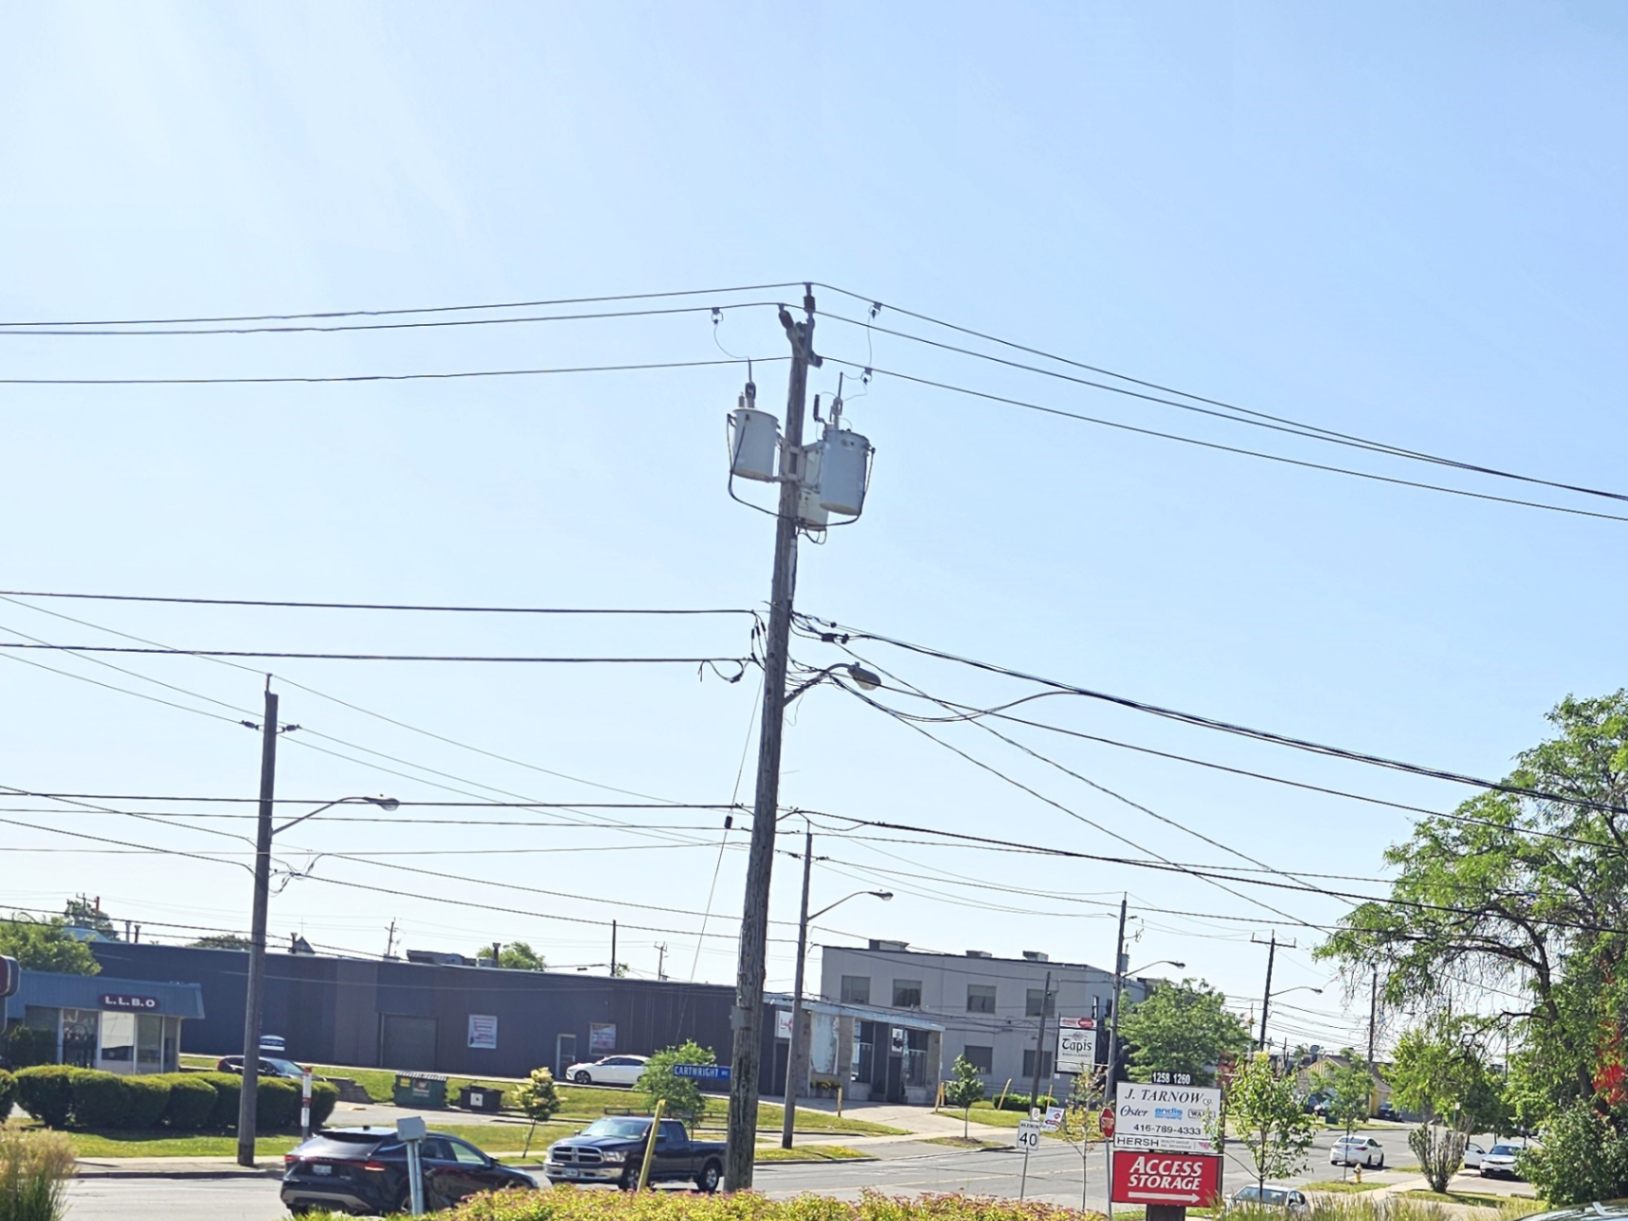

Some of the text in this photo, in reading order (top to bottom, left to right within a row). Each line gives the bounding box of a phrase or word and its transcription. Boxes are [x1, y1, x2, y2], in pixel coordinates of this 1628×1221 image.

[1061, 1037, 1093, 1054] Tapis
[674, 1066, 719, 1078] CARTWRIGHT
[1152, 1072, 1191, 1085] 1258 1260
[1124, 1088, 1136, 1100] J.
[1140, 1088, 1205, 1104] TARNOW
[1120, 1105, 1149, 1118] Oster
[1133, 1123, 1202, 1136] 416-789-4333
[1019, 1132, 1038, 1147] 40
[1116, 1136, 1160, 1148] HERSH
[1127, 1174, 1203, 1191] STORAGE
